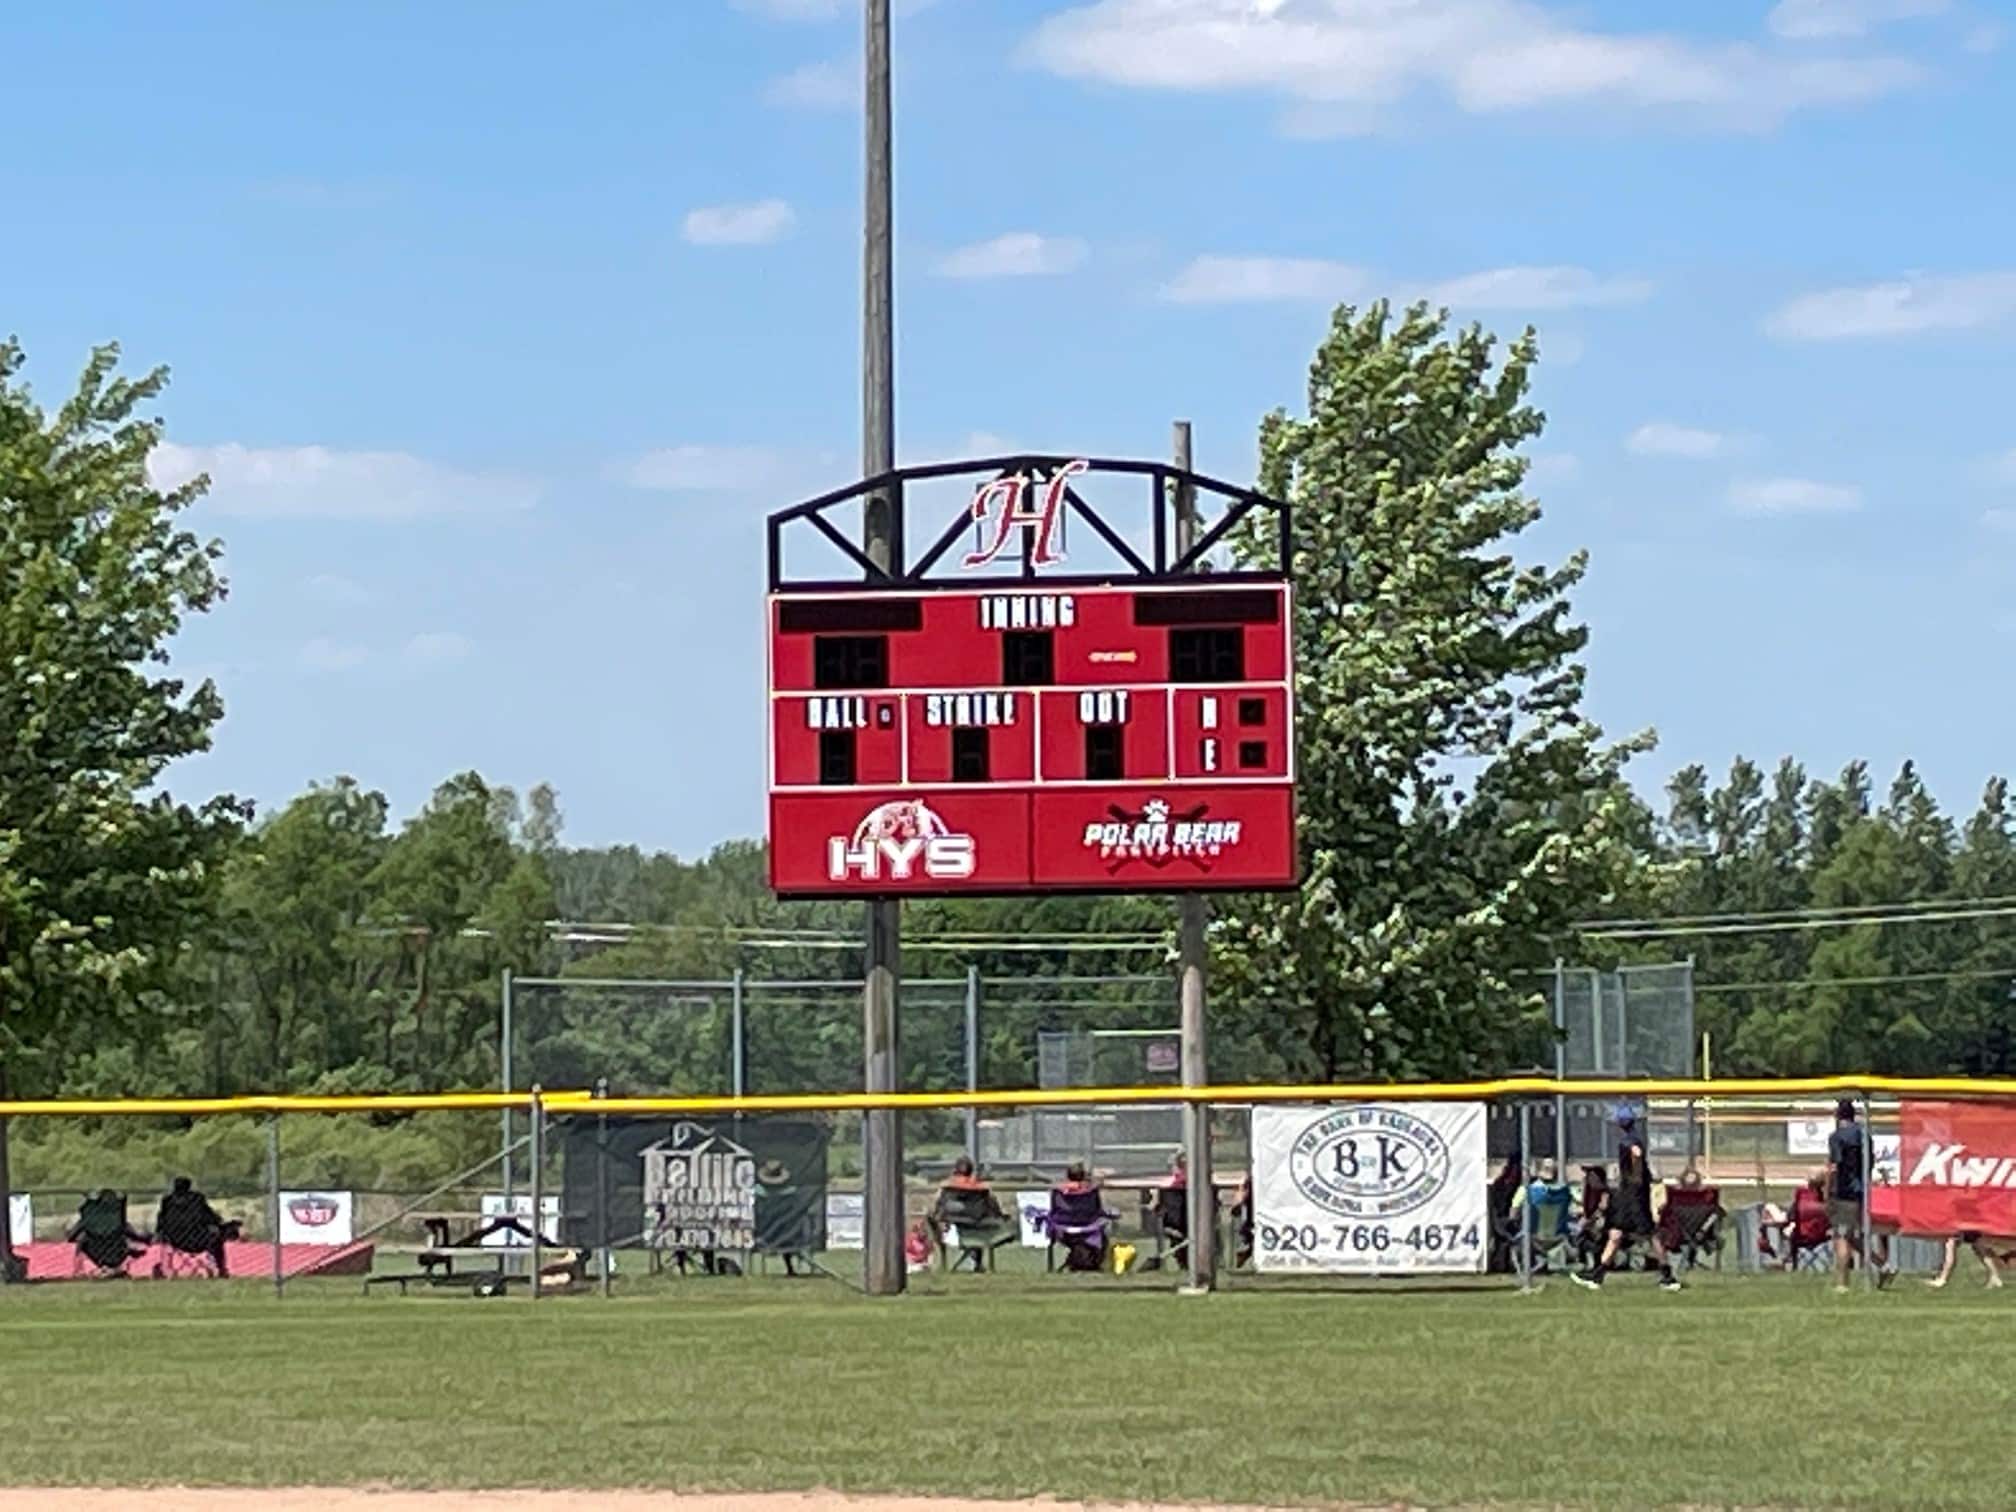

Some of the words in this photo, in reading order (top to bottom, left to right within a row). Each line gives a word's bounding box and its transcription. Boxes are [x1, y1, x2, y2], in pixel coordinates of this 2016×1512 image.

[961, 459, 1090, 570] H
[980, 595, 1075, 631] INNING
[807, 697, 868, 729] BALL
[926, 694, 1016, 727] STRIKE
[1079, 690, 1128, 724] OUT
[1204, 738, 1216, 771] E
[1082, 821, 1169, 849] POLAR
[1172, 820, 1242, 846] BEAR
[828, 833, 977, 881] HYS
[1333, 1137, 1360, 1179] B
[1375, 1135, 1411, 1180] K
[1260, 1223, 1481, 1251] 920-766-4674
